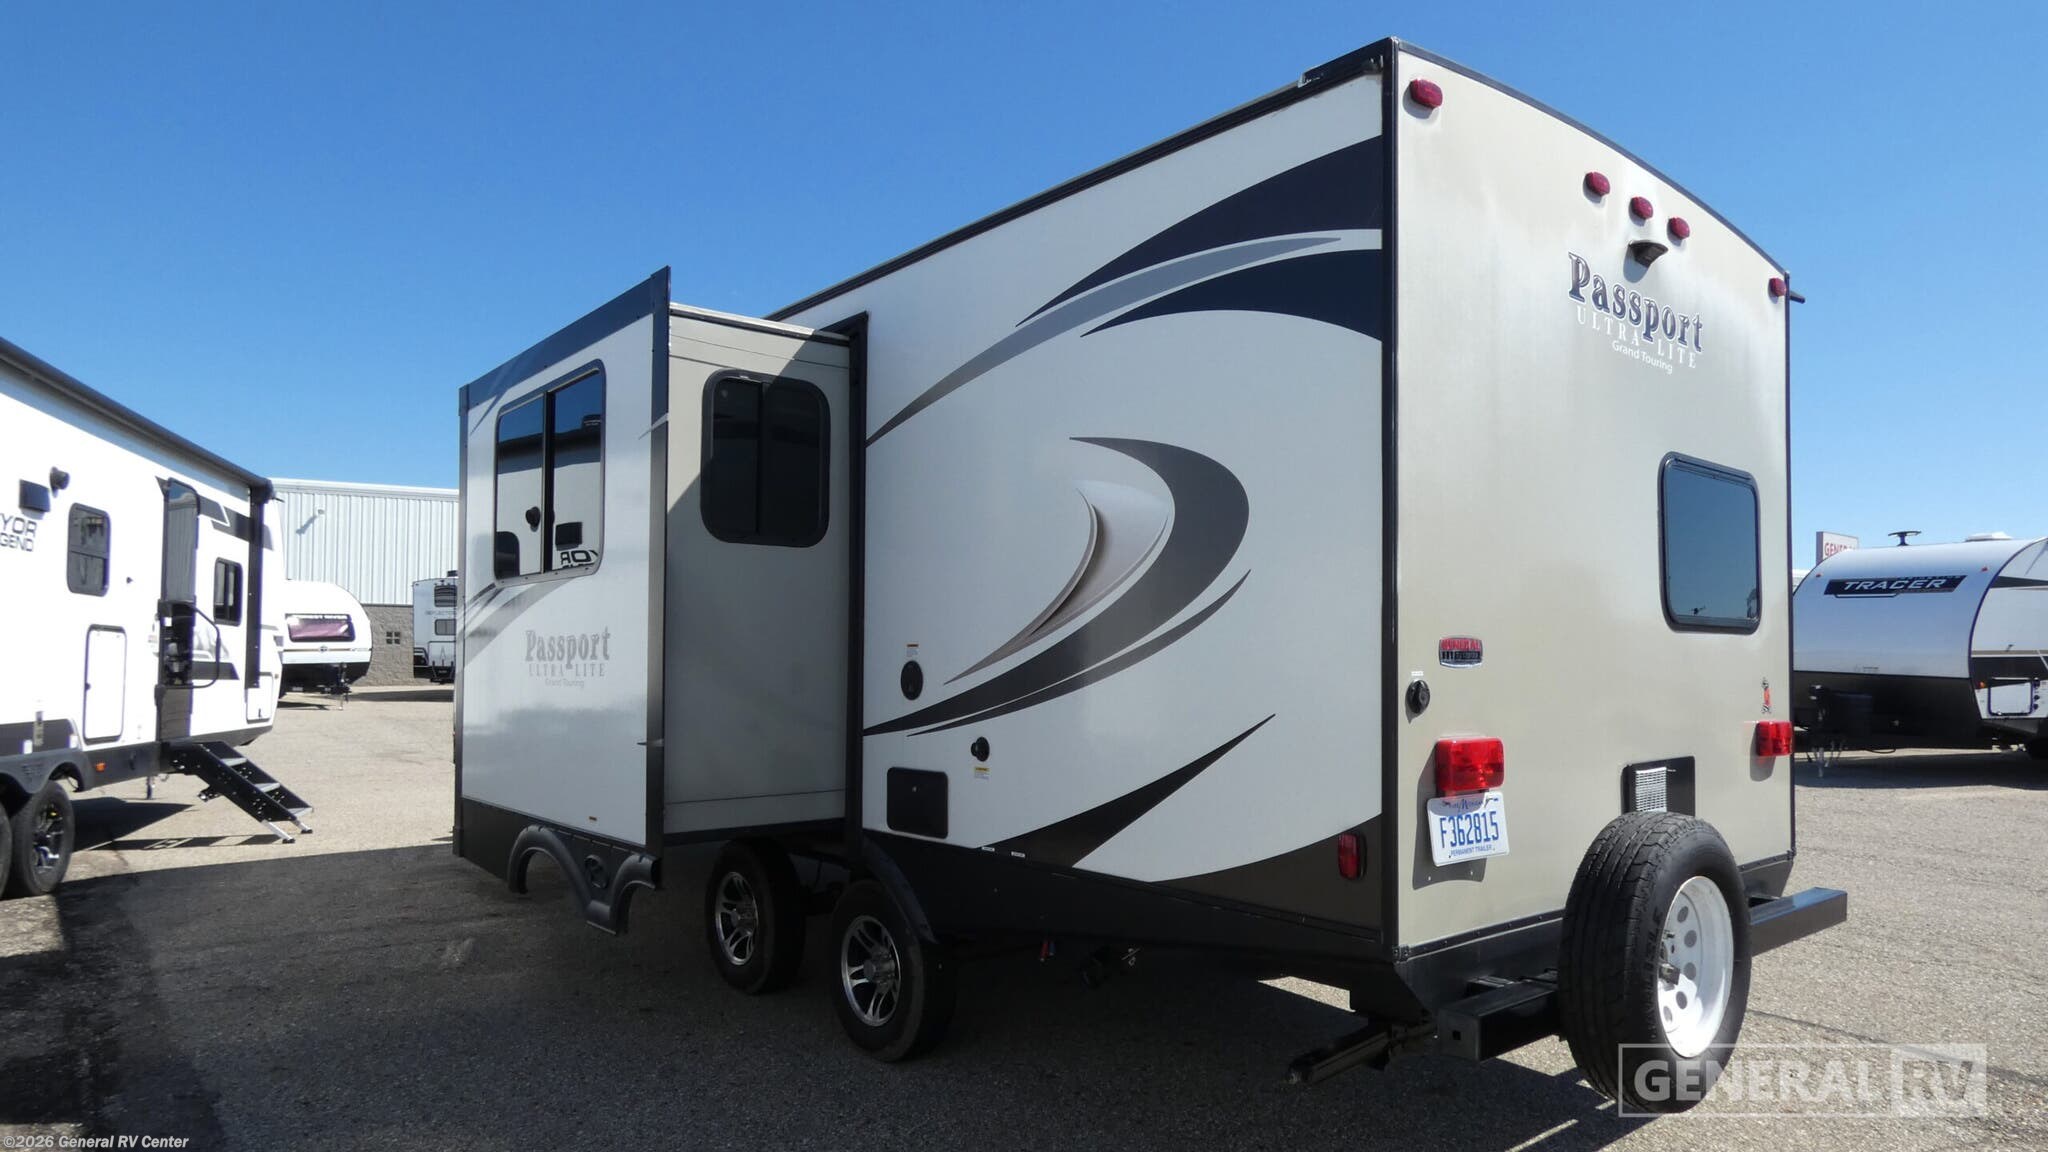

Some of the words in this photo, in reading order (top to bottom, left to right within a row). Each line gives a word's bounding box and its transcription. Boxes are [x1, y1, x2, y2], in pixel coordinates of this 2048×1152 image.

[1568, 251, 1703, 352] Passport
[1577, 305, 1640, 347] ULTRA
[1657, 338, 1697, 369] LITE
[1612, 340, 1640, 361] Grand
[1641, 351, 1673, 374] Touring
[1843, 579, 1946, 591] TRACER
[525, 626, 611, 670] Passport
[575, 663, 606, 677] LITE
[1439, 811, 1499, 848] F362815
